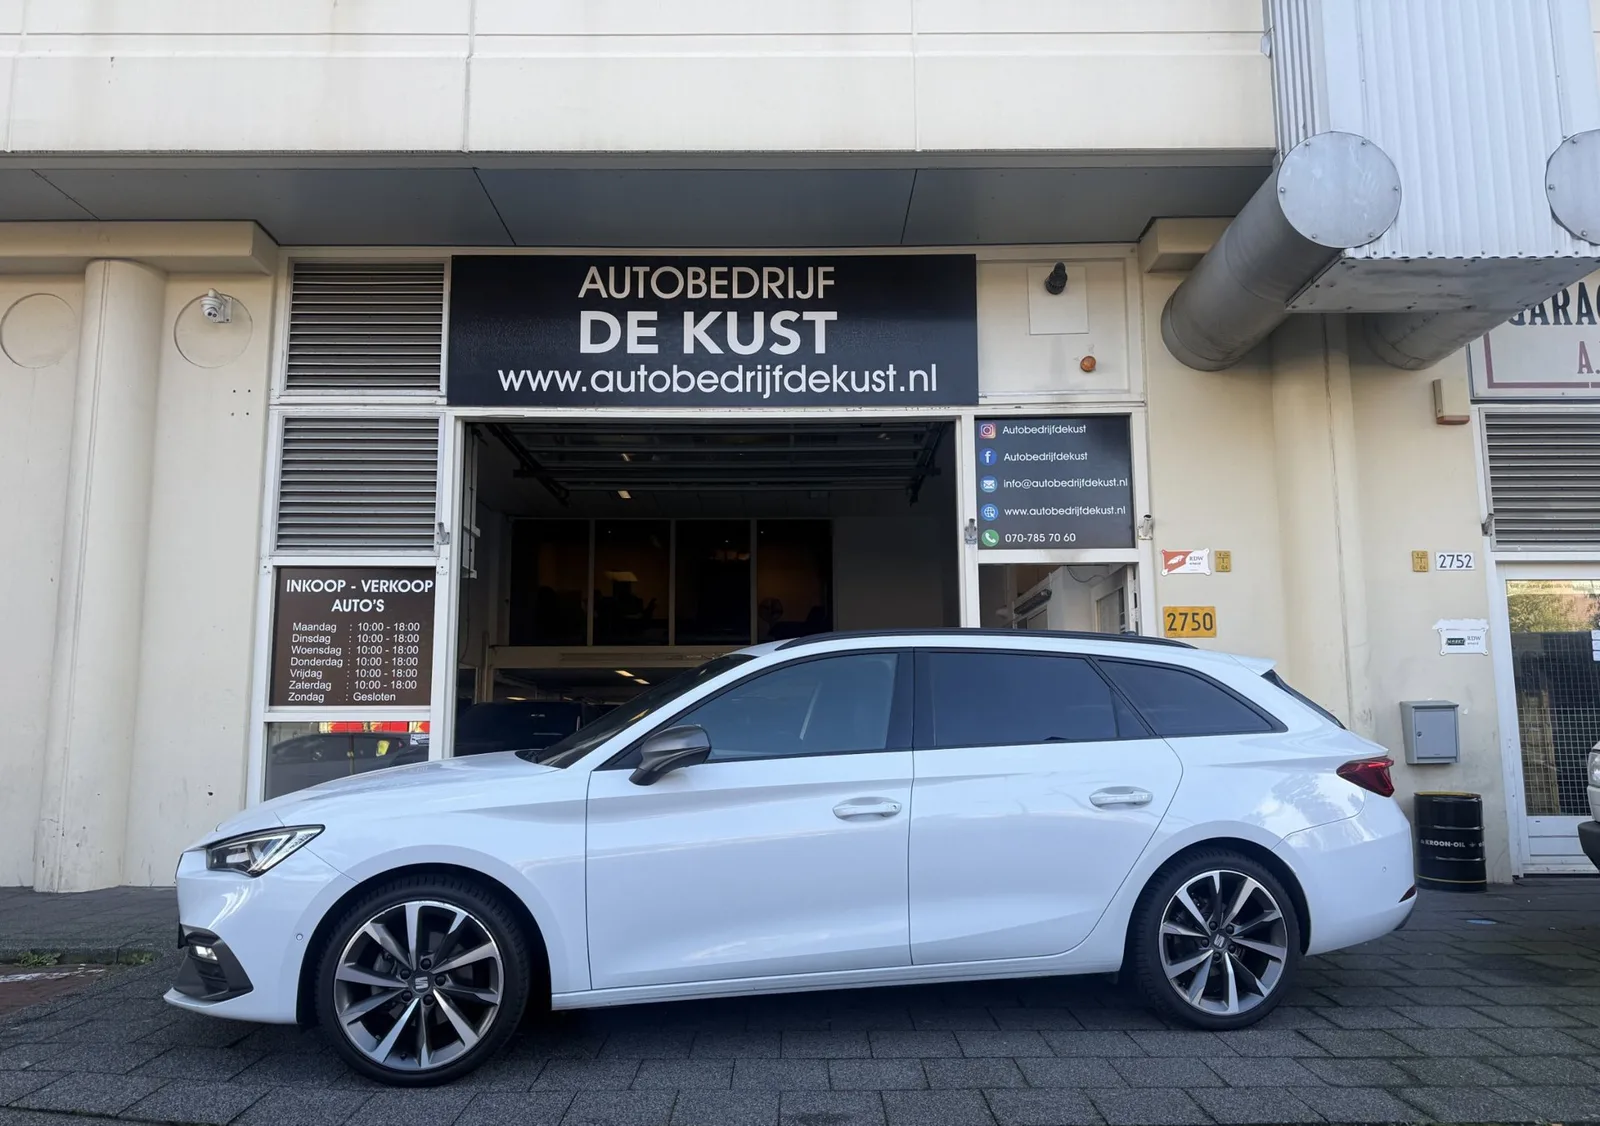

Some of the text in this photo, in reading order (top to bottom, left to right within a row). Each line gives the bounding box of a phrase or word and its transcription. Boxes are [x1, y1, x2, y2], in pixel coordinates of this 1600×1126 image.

[578, 265, 836, 299] AUTOBEDRIJF
[579, 309, 839, 355] DE KUST
[497, 363, 938, 399] www.autobedrijfdekust.nl
[1002, 425, 1087, 435] Autobedrijfdekust
[1003, 452, 1088, 462] Autobedrijfdekust
[1003, 478, 1129, 489] info@autobedrijfdekust.nl
[1004, 506, 1126, 517] www.autobedrijfdekust.nl
[1005, 533, 1076, 543] 070-785 70 60
[1438, 554, 1473, 569] 2752
[286, 579, 347, 593] INKOOP
[361, 579, 434, 593] VERKOOP
[331, 599, 385, 613] AUTO'S
[292, 622, 337, 633] Maandag
[358, 623, 383, 631] 10:00
[393, 623, 420, 631] 18:00
[1167, 612, 1213, 632] 2750
[292, 634, 331, 645] Dinsdag
[357, 634, 383, 643] 10:00
[393, 634, 420, 643] 18:00
[291, 646, 342, 656] Woensdag
[356, 646, 382, 655] 10:00
[393, 646, 419, 655] 18:00
[290, 657, 343, 668] Donderdag
[355, 657, 382, 666] 10:00
[392, 657, 418, 666] 18:00
[290, 669, 323, 679] Vrijdag
[355, 669, 381, 678] 10:00
[391, 669, 418, 678] 18:00
[289, 680, 332, 691] Zaterdag
[354, 681, 381, 690] 10:00
[391, 681, 417, 690] 18:00
[288, 692, 325, 703] Zondag
[353, 692, 396, 702] Gesloten
[1425, 839, 1466, 848] KROON-OIL
